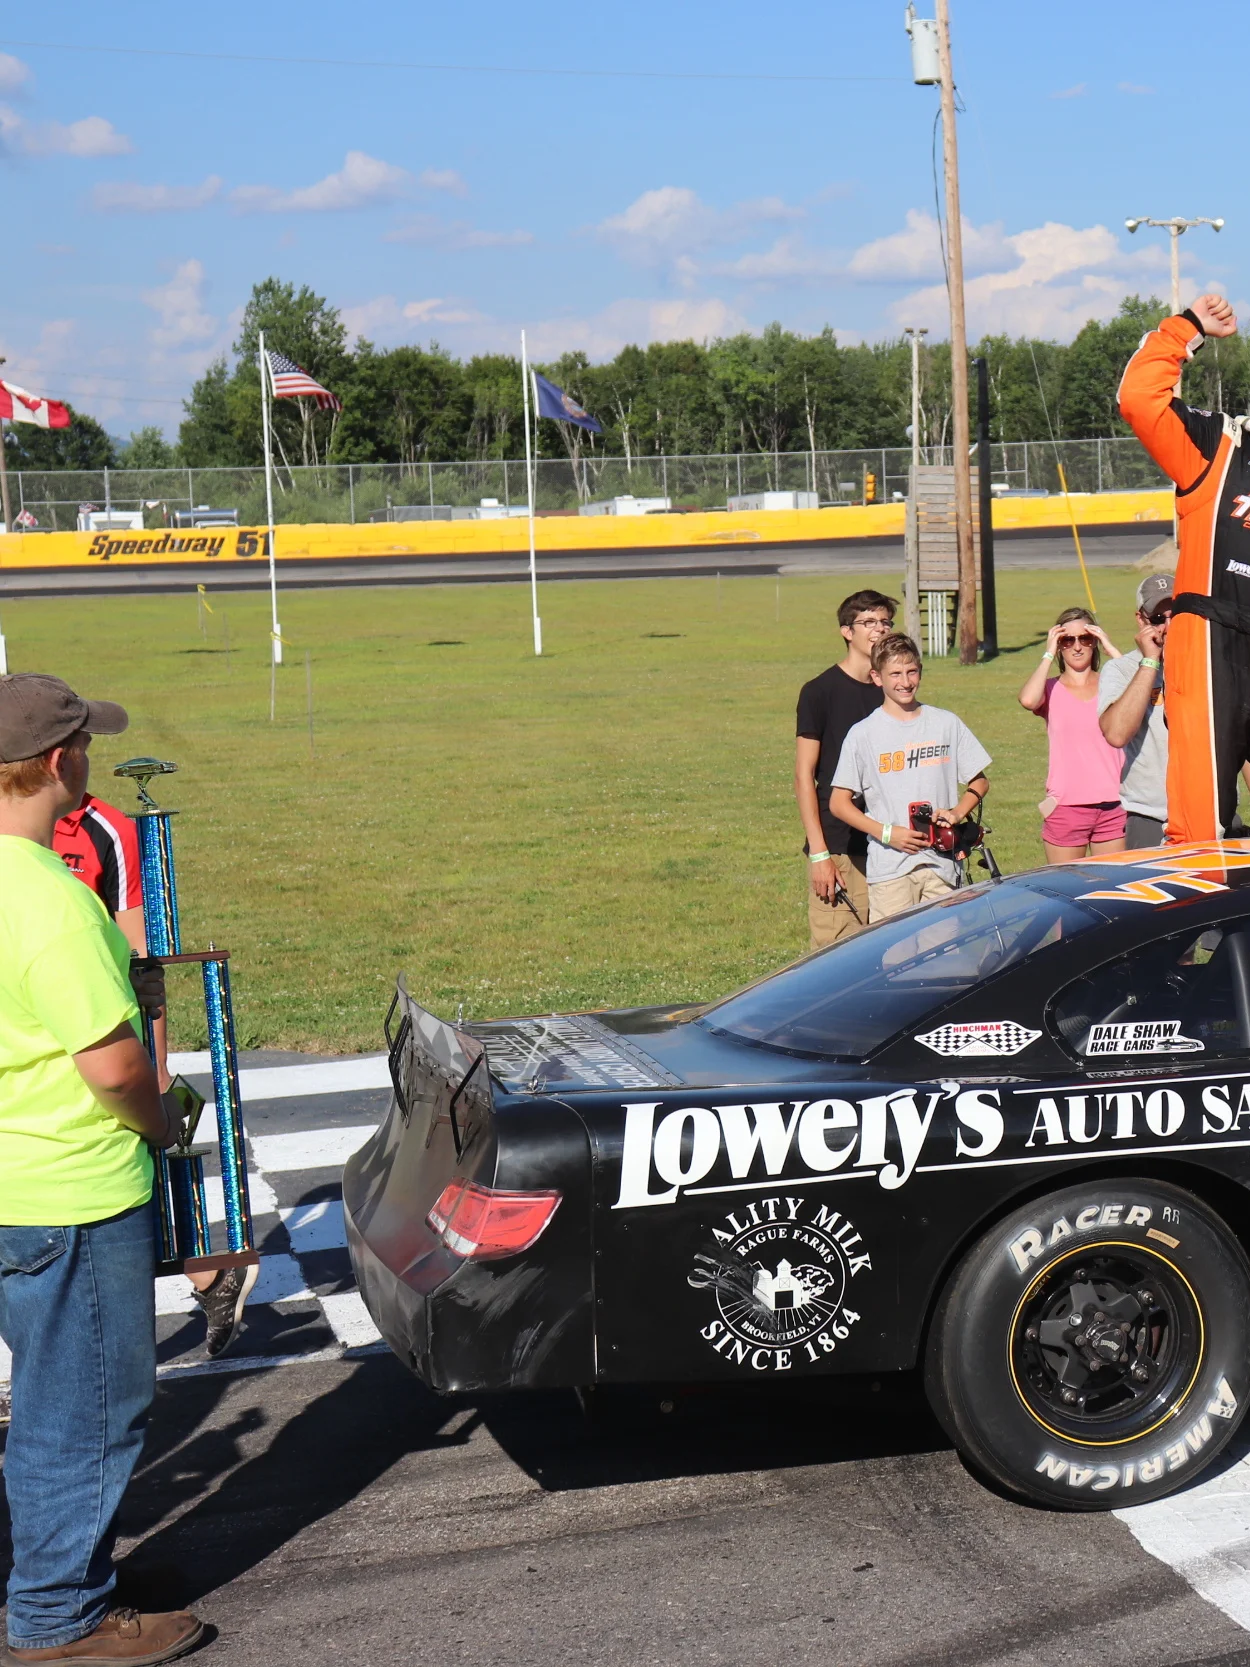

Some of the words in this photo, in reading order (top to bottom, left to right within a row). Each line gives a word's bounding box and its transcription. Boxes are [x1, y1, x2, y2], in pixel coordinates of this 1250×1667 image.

[88, 533, 225, 560] Speedway
[235, 530, 275, 557] 51
[879, 751, 905, 773] 58
[907, 745, 950, 769] HEBERT
[953, 1024, 1002, 1033] HINCHMAN
[1092, 1025, 1130, 1041] DALE
[1134, 1022, 1178, 1039] SHAW
[1090, 1041, 1121, 1053] RACE
[1124, 1039, 1156, 1051] CARS
[611, 1082, 1004, 1209] Lowery's
[1024, 1087, 1186, 1148] AUTO
[792, 1229, 836, 1265] FARMS
[811, 1204, 873, 1278] MILK
[1008, 1204, 1153, 1273] RACER
[807, 1312, 823, 1327] VT
[699, 1319, 793, 1371] SINCE
[803, 1307, 862, 1364] 1864
[1035, 1376, 1239, 1491] AMERICAN
